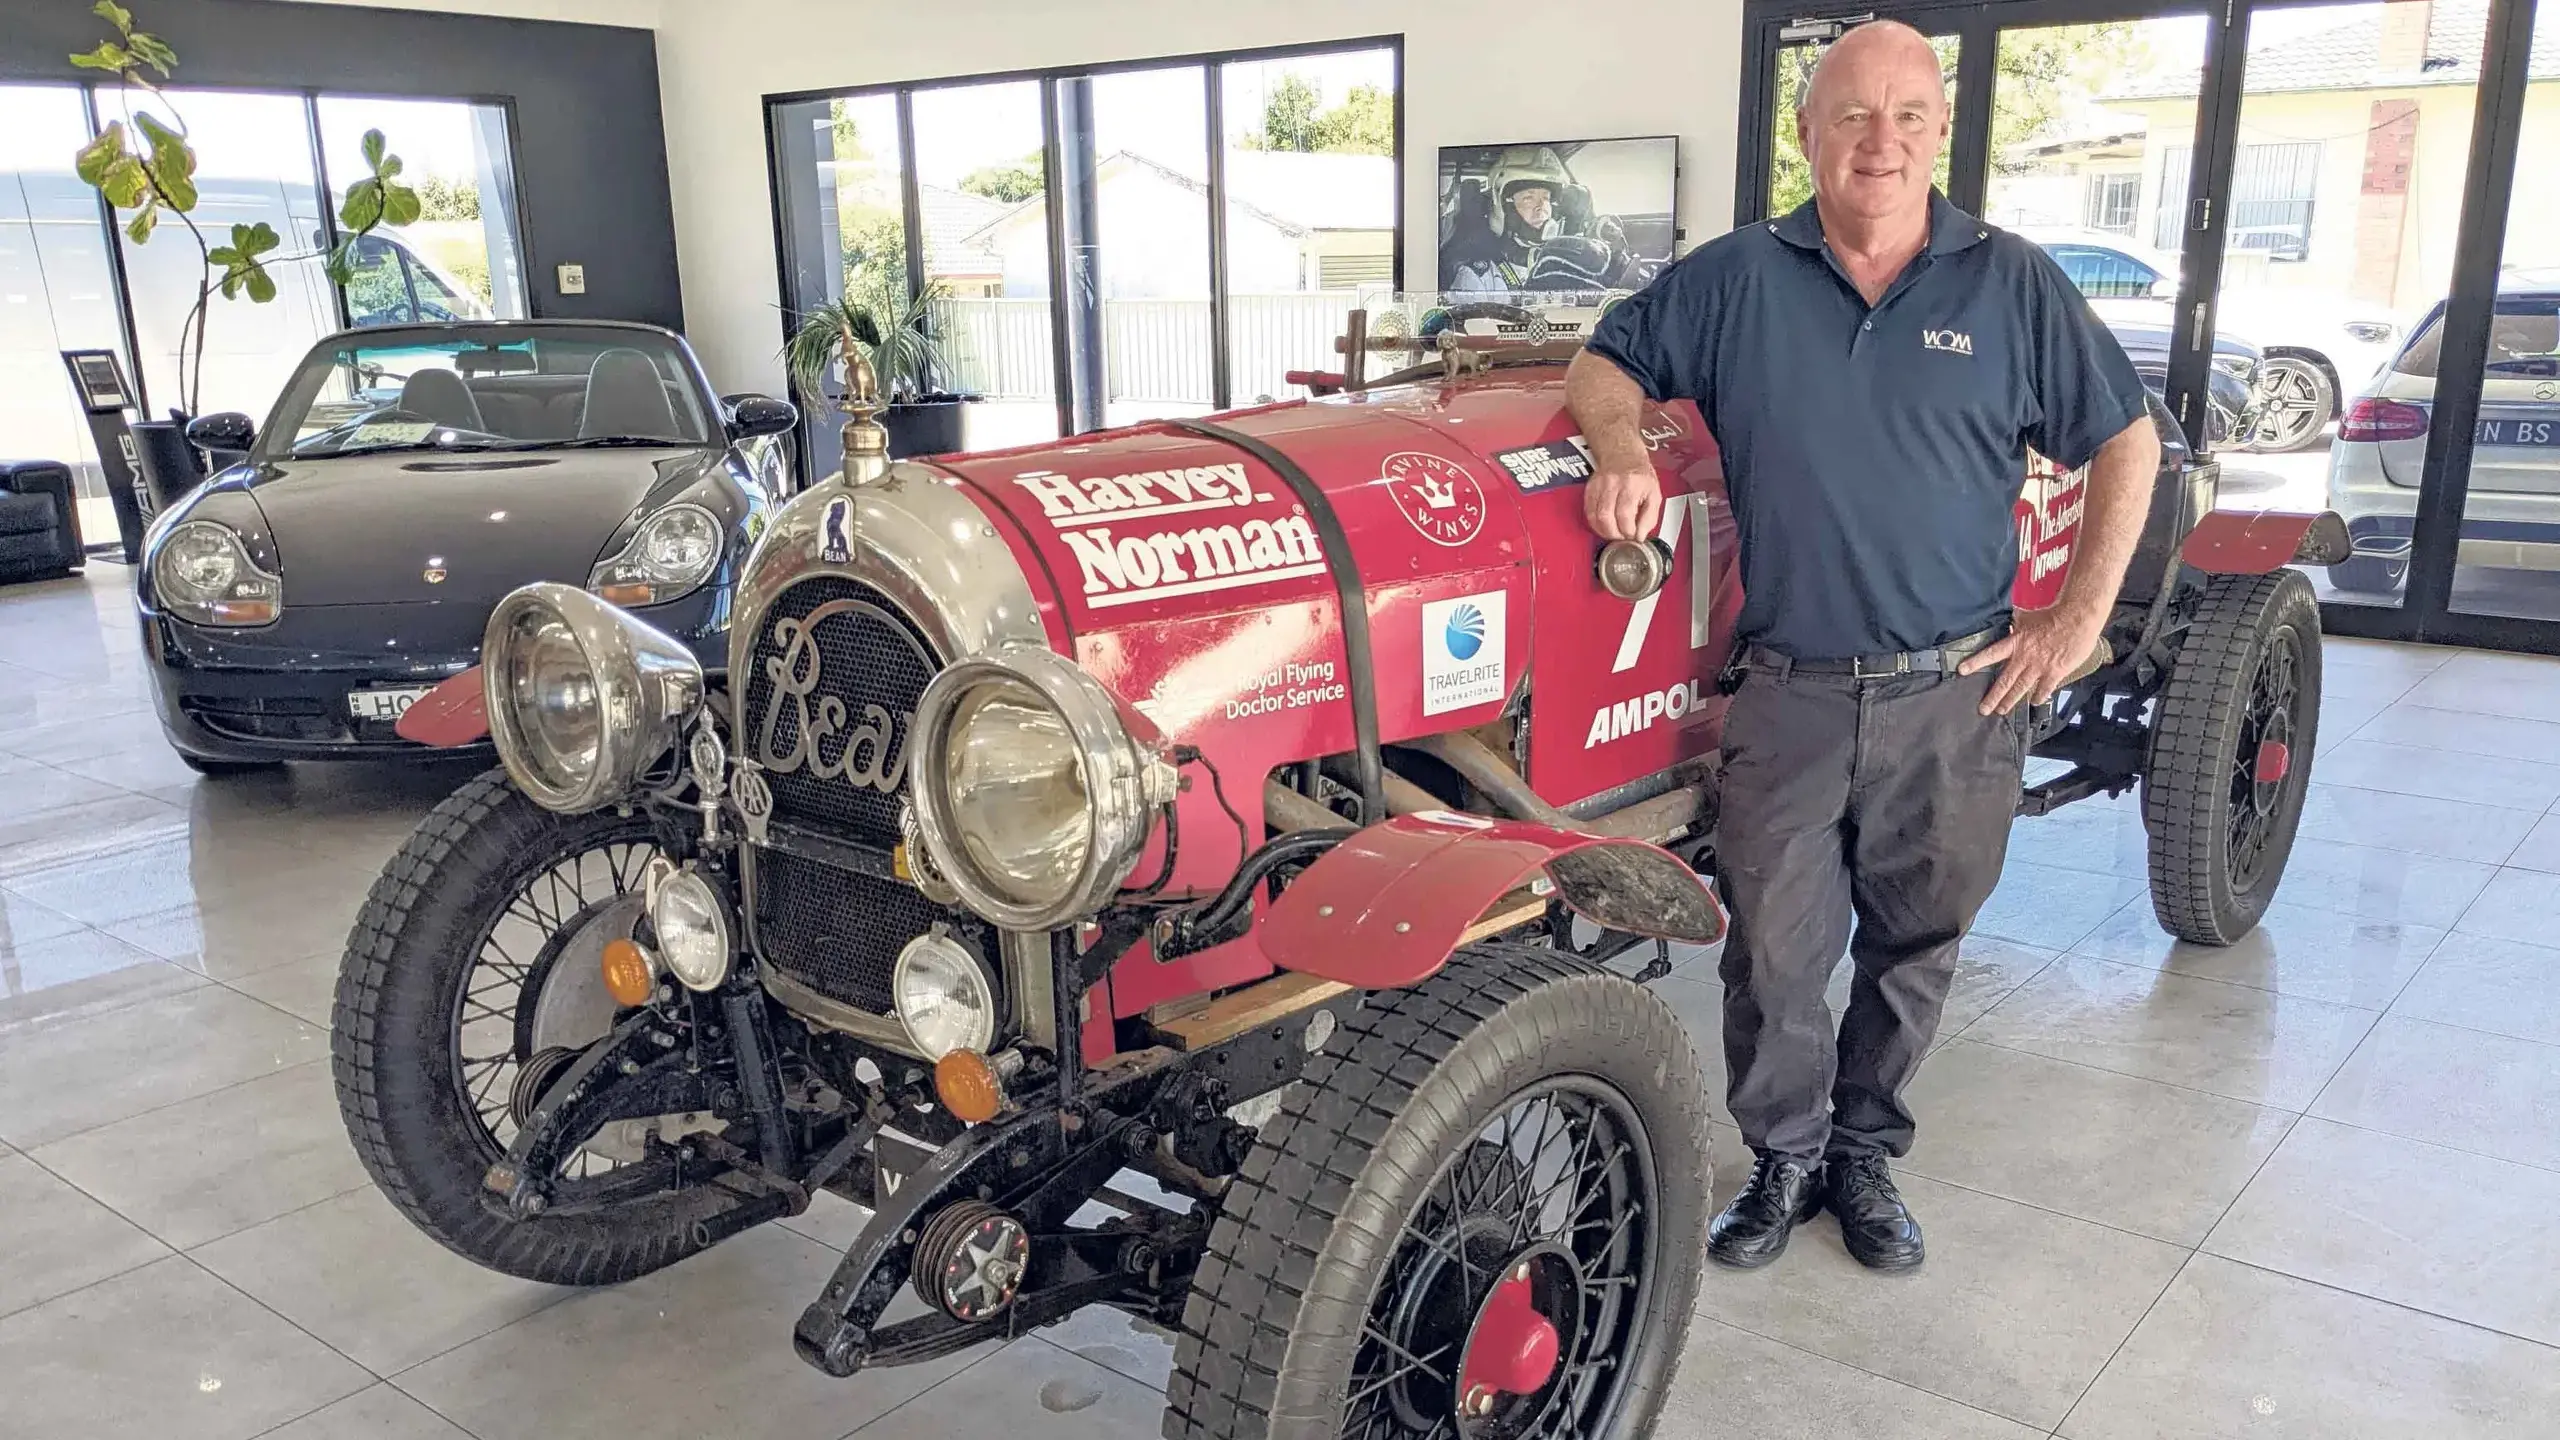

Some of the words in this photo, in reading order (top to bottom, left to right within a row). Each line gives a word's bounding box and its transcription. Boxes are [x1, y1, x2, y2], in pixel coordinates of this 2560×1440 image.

[1923, 329, 1972, 351] WOM
[118, 433, 155, 513] AMG
[1391, 456, 1458, 482] IRVINE
[1500, 447, 1550, 471] SURF
[1516, 457, 1589, 489] SUMMIT
[1013, 463, 1252, 517] Harvey
[1417, 502, 1479, 538] WINES
[2039, 510, 2056, 544] The
[824, 548, 848, 563] BEAN
[1060, 514, 1323, 595] Norman
[1286, 661, 1334, 688] Flying
[1429, 663, 1500, 691] TRAVELRITE
[374, 695, 415, 716] HO
[760, 600, 925, 793] Bea
[1227, 694, 1285, 720] Doctor
[1286, 683, 1346, 708] Service
[1430, 685, 1500, 706] INTERNATIONAL
[1584, 678, 1707, 750] AMPOL
